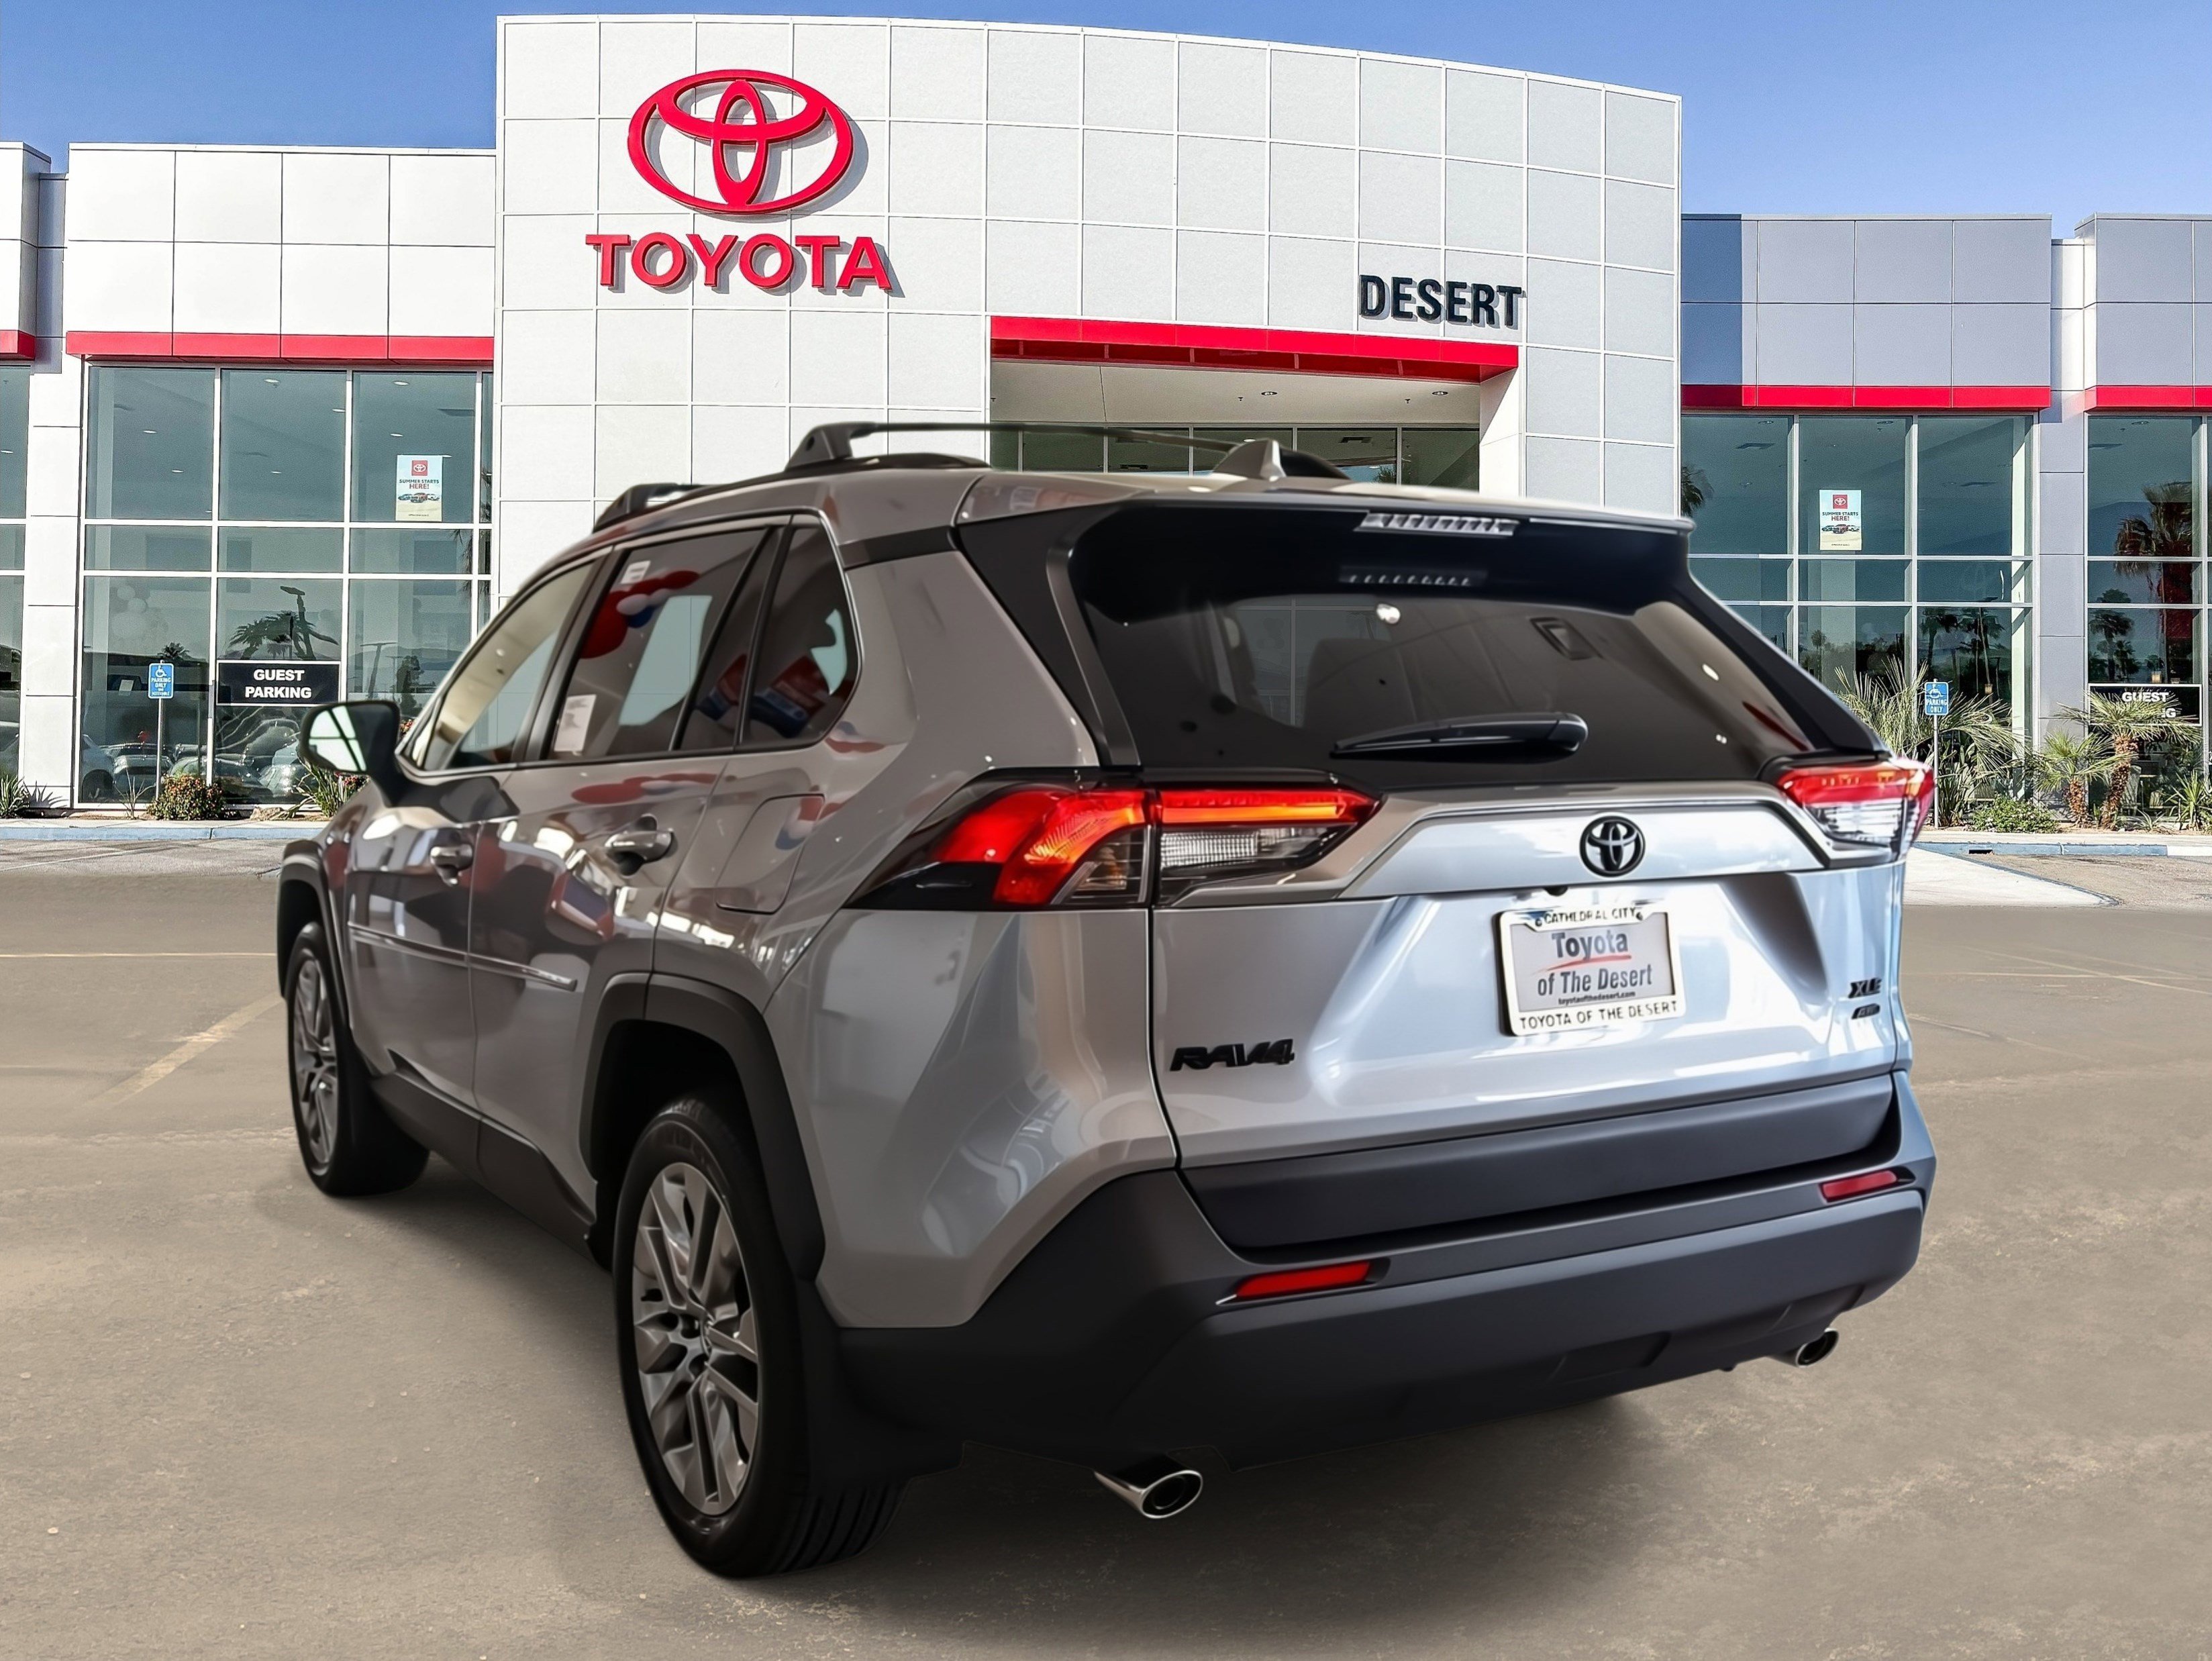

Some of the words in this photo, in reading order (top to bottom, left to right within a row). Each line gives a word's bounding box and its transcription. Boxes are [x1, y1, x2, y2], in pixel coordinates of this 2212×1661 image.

[585, 232, 893, 290] TOYOTA
[1359, 274, 1523, 327] DESERT
[253, 669, 305, 681] GUEST
[245, 687, 312, 699] PARKING
[2121, 691, 2169, 703] GUEST
[1930, 705, 1944, 713] ONLY
[1544, 909, 1608, 924] CATHEDRAL
[1612, 907, 1636, 919] CITY
[1551, 929, 1628, 962] Toyota
[1538, 973, 1555, 996] of
[1560, 970, 1591, 993] The
[1598, 964, 1652, 990] Desert
[1848, 977, 1882, 999] XLE
[1519, 1013, 1572, 1030] TOYOTA
[1577, 1009, 1593, 1023] OF
[1599, 1007, 1623, 1021] THE
[1628, 1000, 1677, 1018] DESERT
[1170, 1039, 1295, 1072] RAV4
